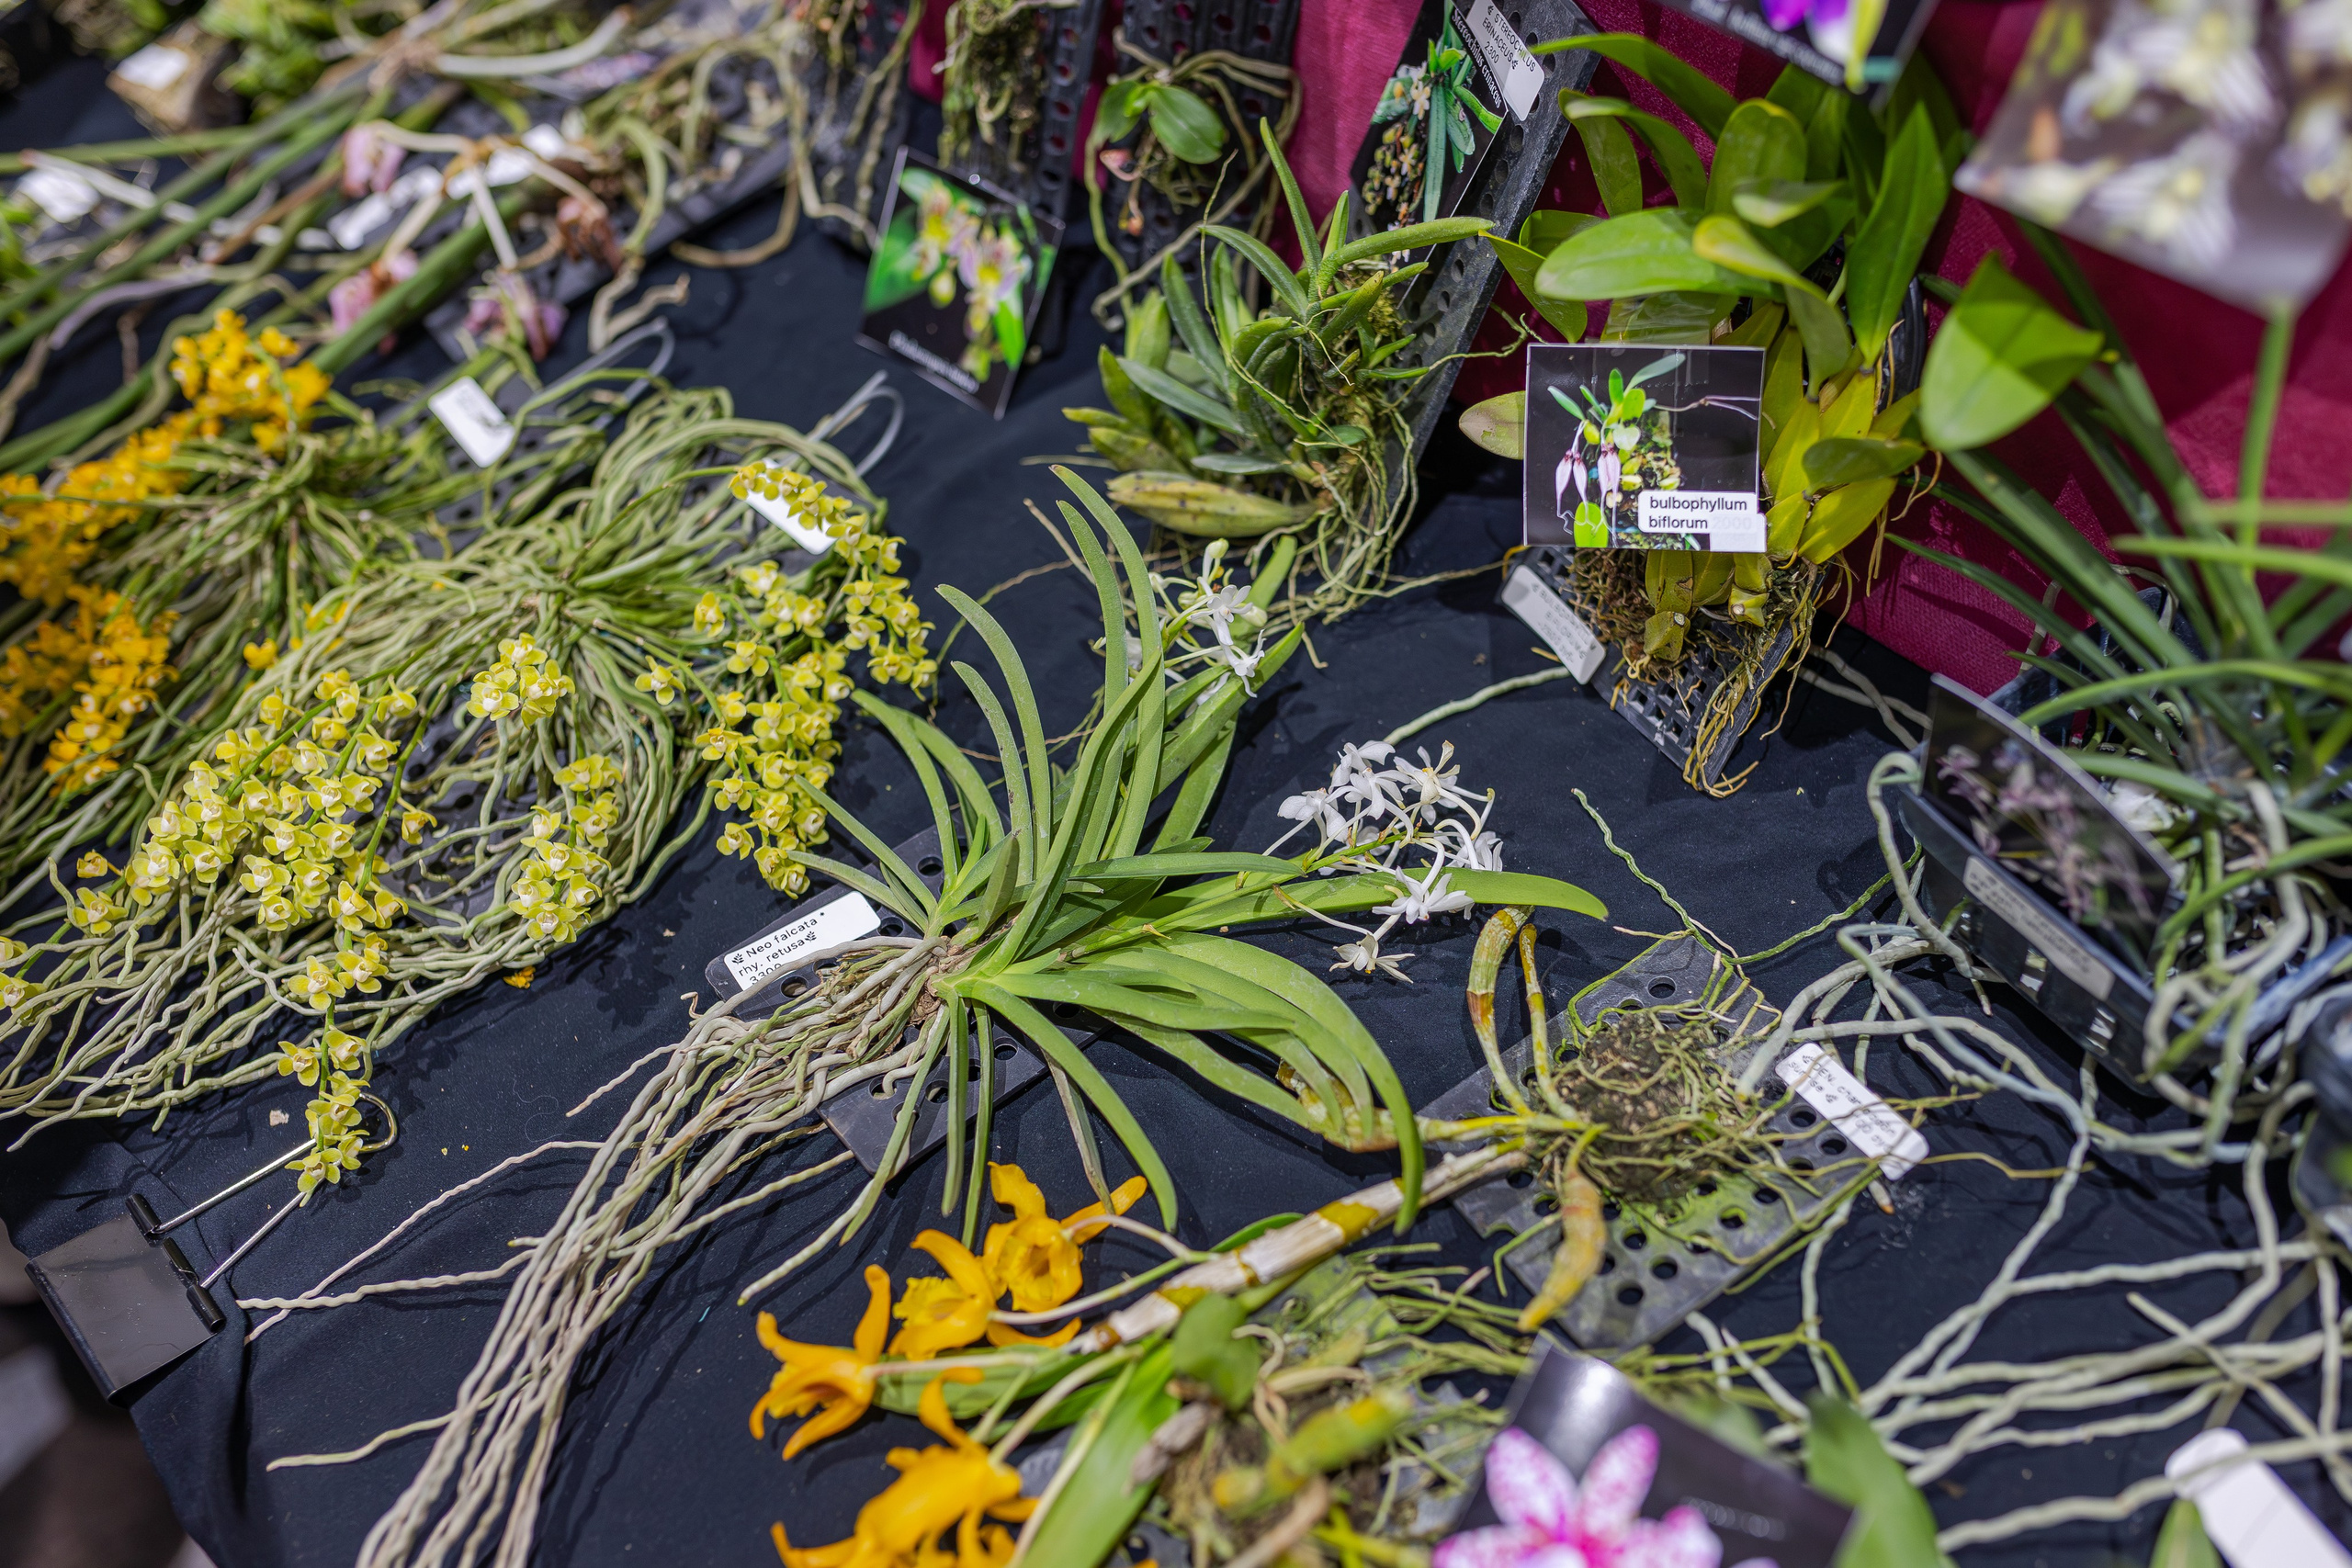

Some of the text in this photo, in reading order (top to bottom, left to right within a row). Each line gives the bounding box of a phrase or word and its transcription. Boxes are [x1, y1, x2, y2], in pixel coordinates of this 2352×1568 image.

[1452, 9, 1502, 108] Stereochilus erinaceus
[1482, 17, 1514, 62] ERINACEUS
[1484, 41, 1499, 64] 2300
[1494, 13, 1536, 73] STEREOCHILUS
[1648, 515, 1708, 529] biflorum
[1650, 496, 1747, 513] bulbophyllum
[745, 918, 818, 958] Neo falcata
[739, 939, 806, 977] rhy. retusa
